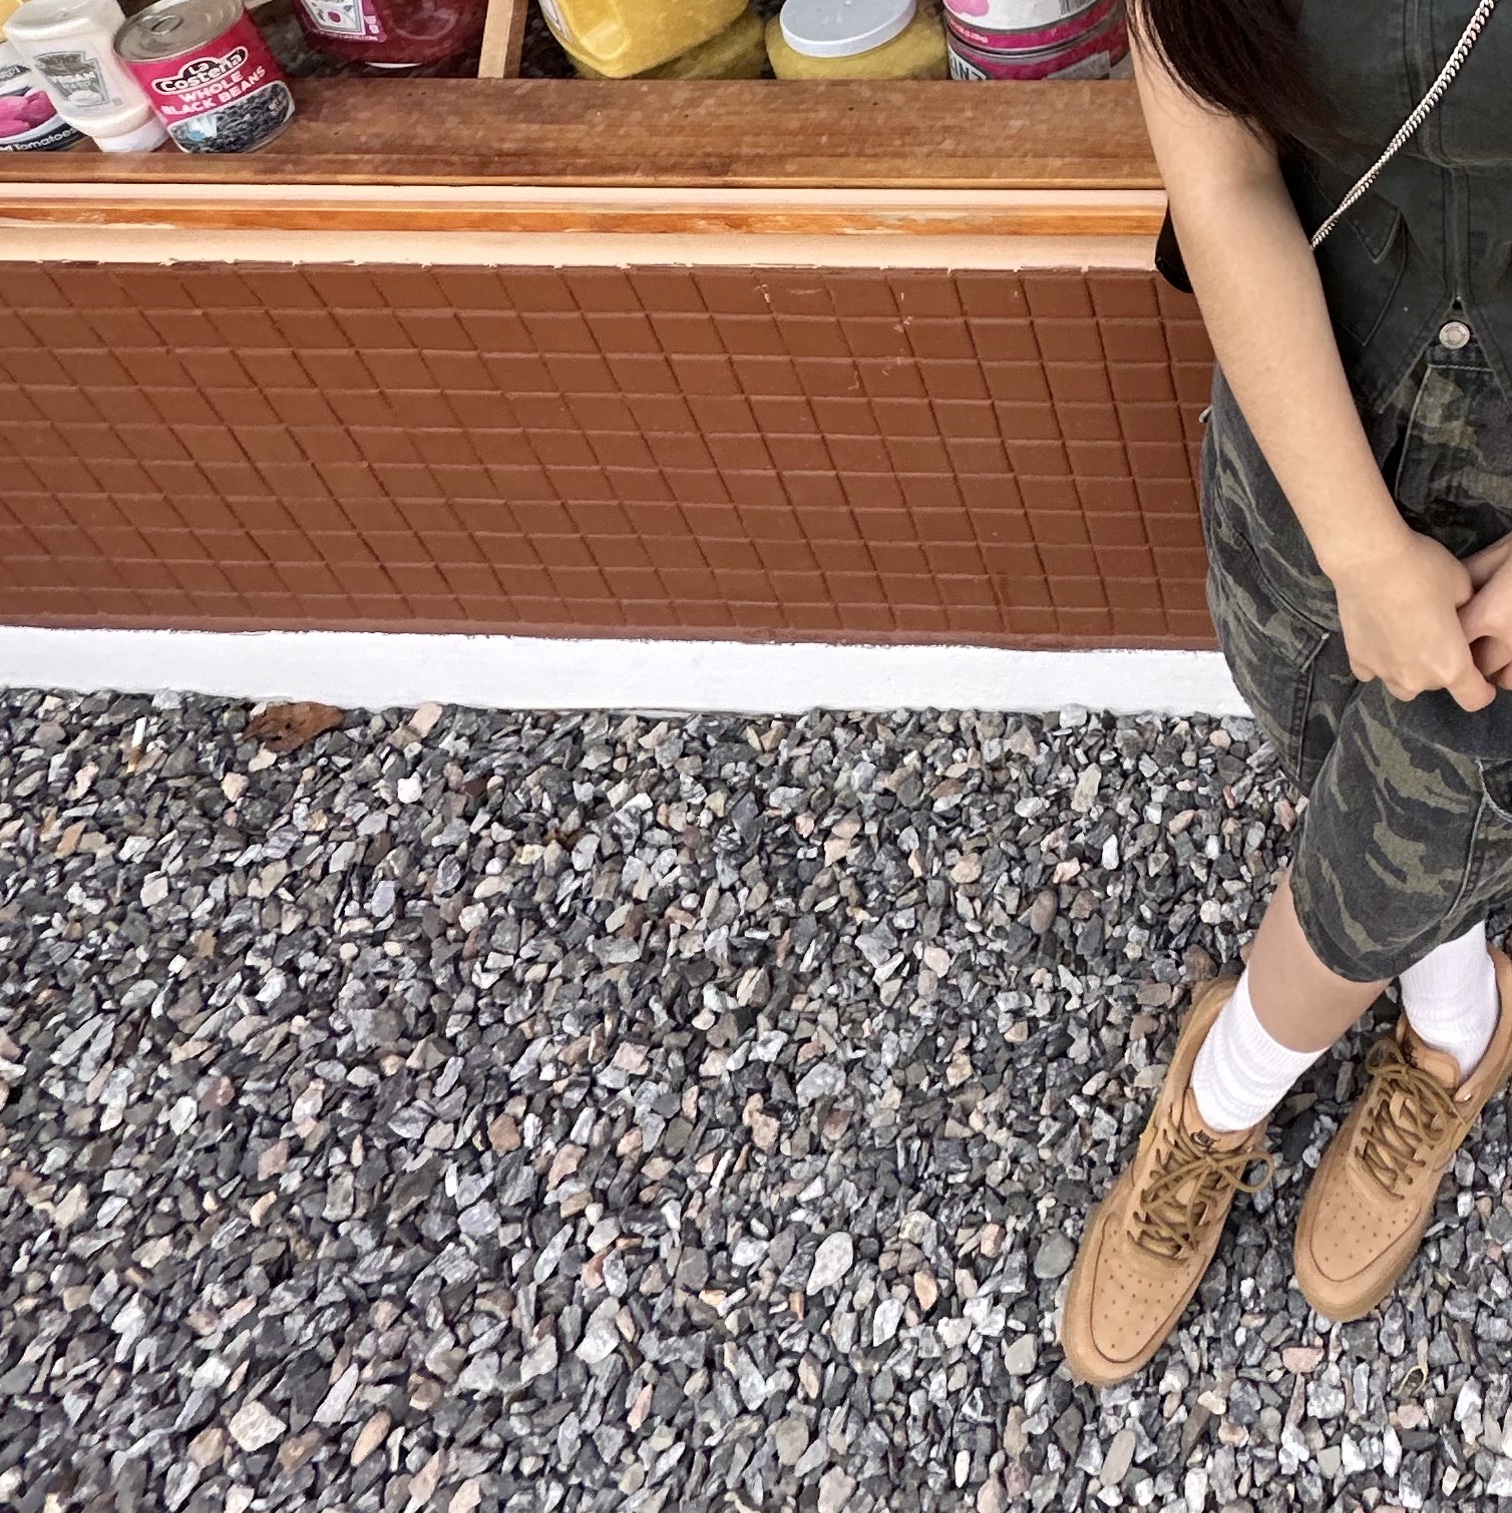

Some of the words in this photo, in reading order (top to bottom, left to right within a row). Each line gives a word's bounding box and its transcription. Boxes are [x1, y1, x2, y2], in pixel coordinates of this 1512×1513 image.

[160, 97, 217, 116] BLACK
[217, 65, 267, 104] BEANS
[178, 70, 244, 104] WHOLE
